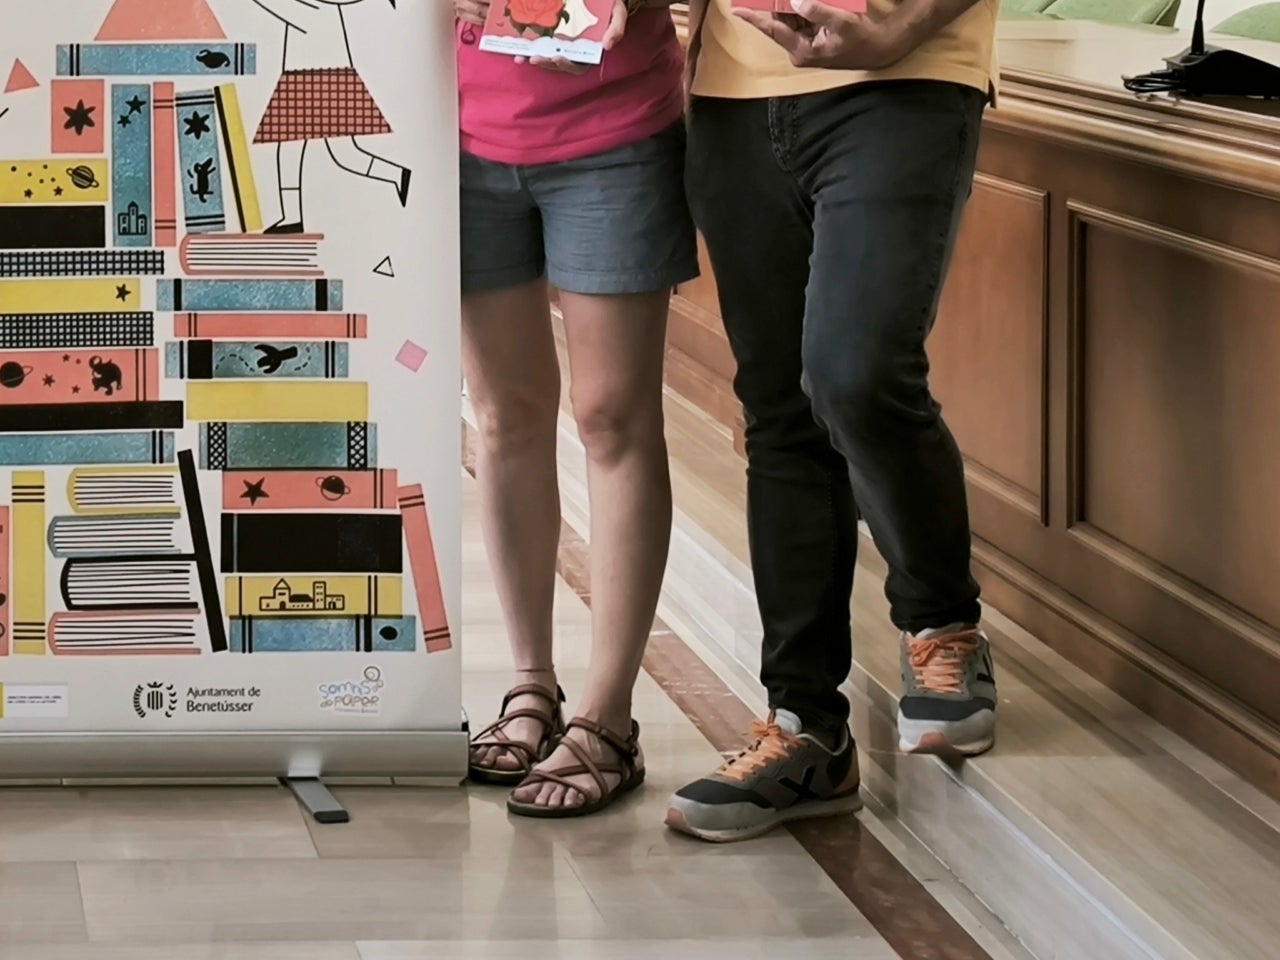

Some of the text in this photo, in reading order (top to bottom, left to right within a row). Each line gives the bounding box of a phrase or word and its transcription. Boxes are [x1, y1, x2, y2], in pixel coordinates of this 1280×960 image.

[186, 686, 262, 699] Ajuntament de
[186, 700, 255, 713] Benetússer
